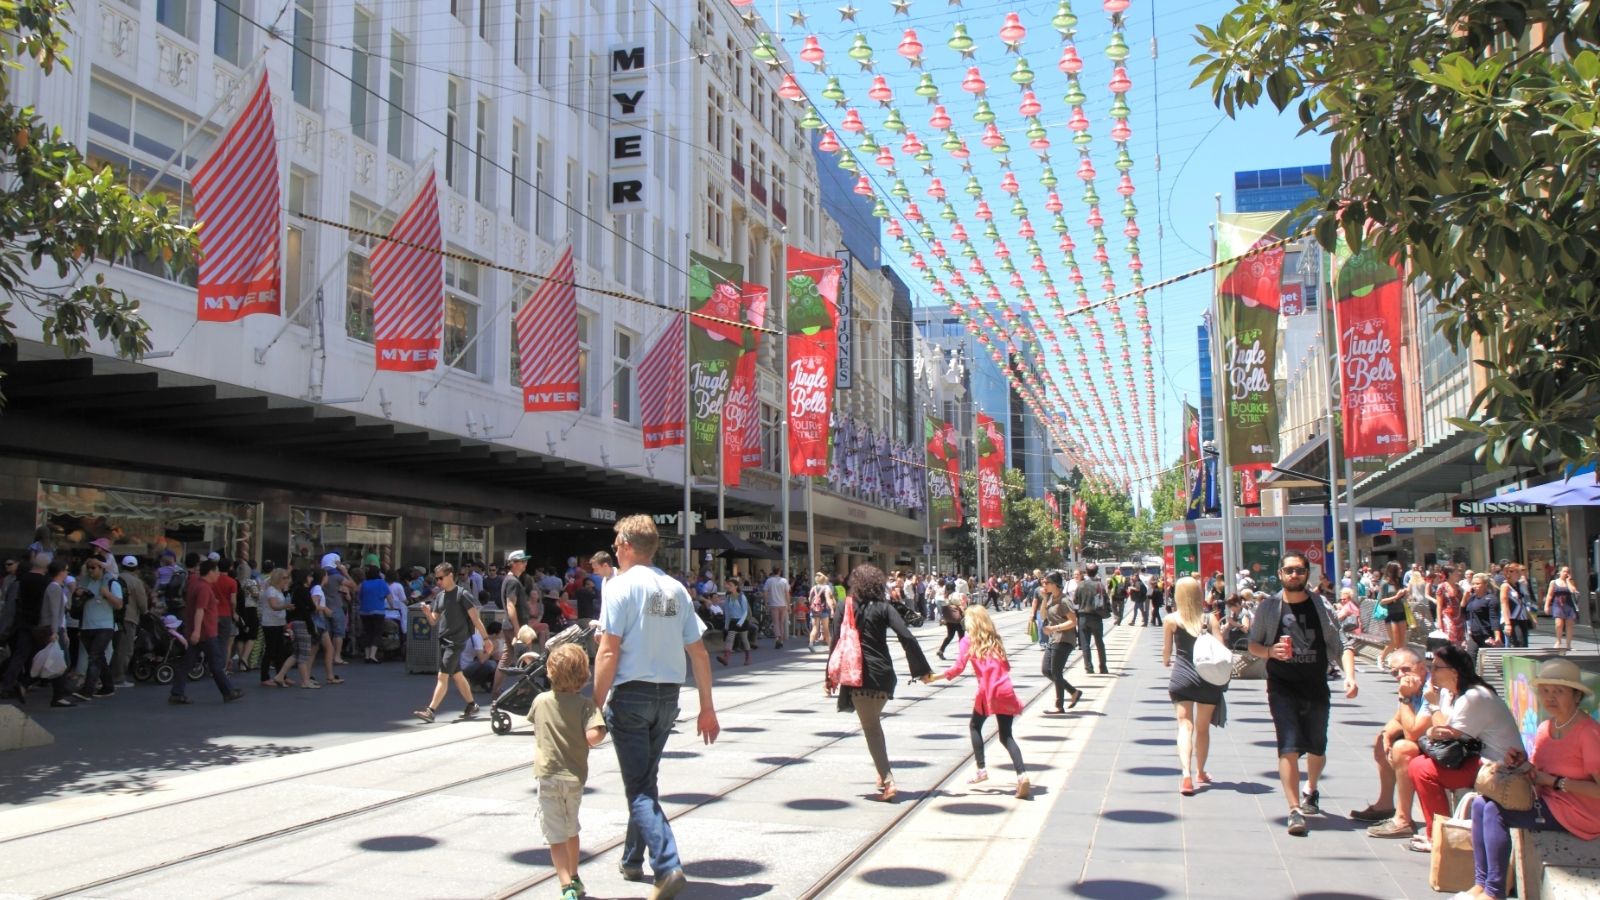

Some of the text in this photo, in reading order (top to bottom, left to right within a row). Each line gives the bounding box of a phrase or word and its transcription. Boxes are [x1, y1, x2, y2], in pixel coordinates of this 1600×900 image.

[613, 46, 645, 204] MYER
[204, 289, 276, 311] MYER
[381, 349, 439, 362] MYER
[838, 320, 849, 381] JONES
[1224, 336, 1267, 373] Jngle
[1342, 327, 1391, 362] Jingle
[690, 363, 730, 397] Jingle
[789, 360, 828, 394] Jingle
[1230, 366, 1270, 400] Bells
[1346, 357, 1397, 391] Bells
[528, 391, 579, 403] MYER
[791, 387, 827, 418] Bells
[1231, 401, 1270, 417] BOURKE
[645, 428, 685, 442] MYER
[591, 508, 617, 521] MYER
